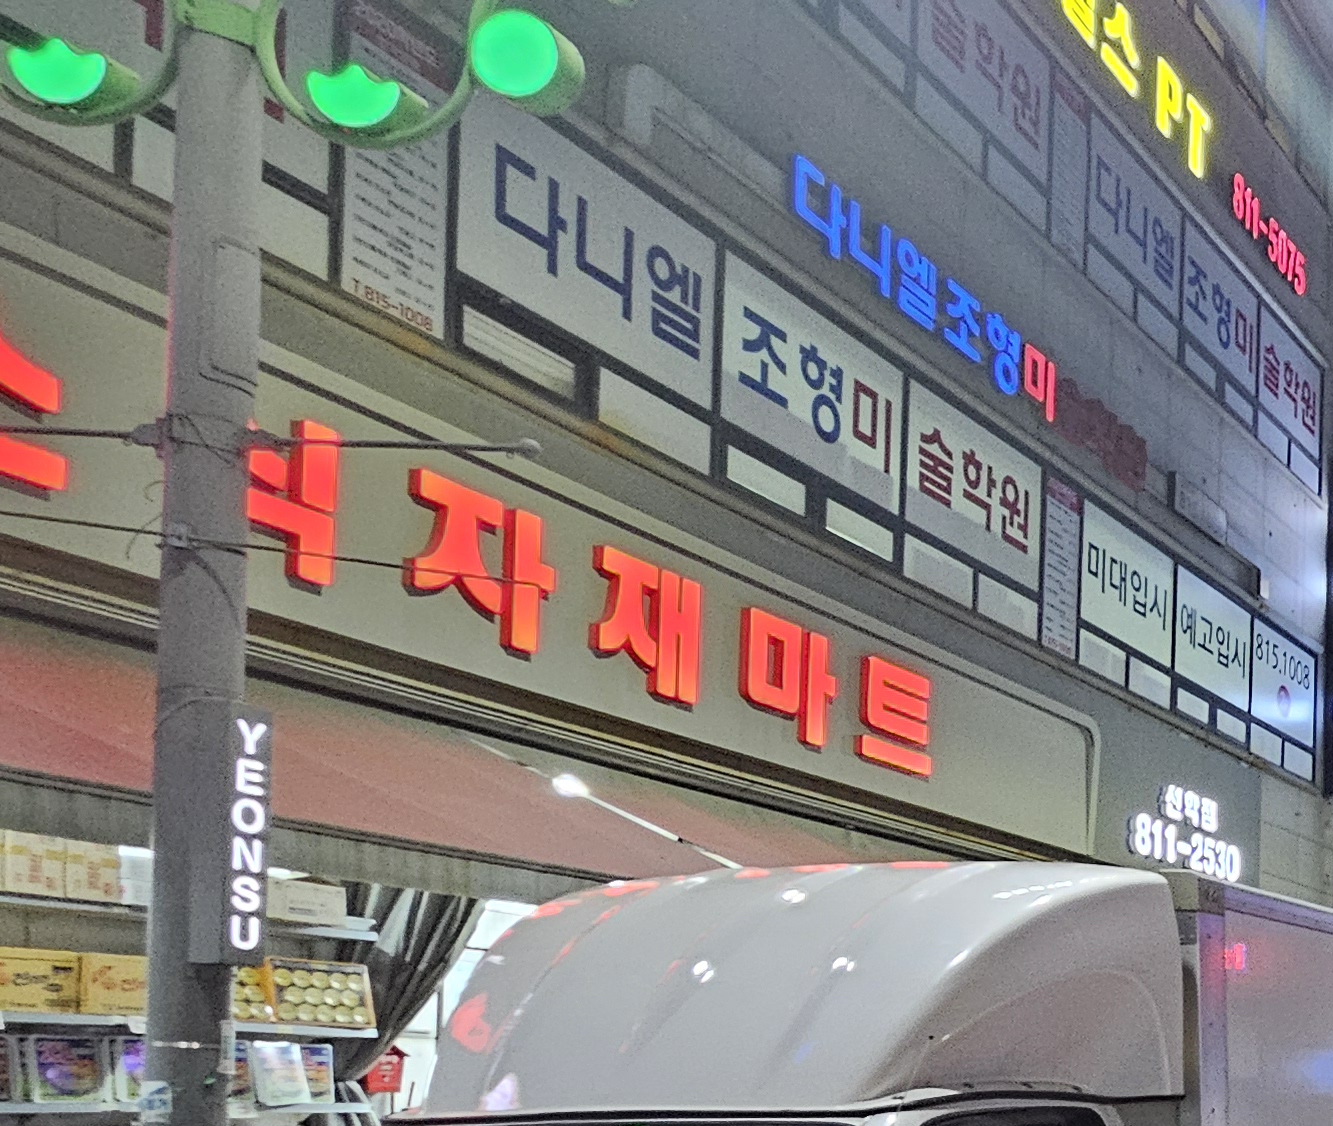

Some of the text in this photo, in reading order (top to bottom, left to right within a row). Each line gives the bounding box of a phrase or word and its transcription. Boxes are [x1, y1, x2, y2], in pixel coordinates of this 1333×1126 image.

[1156, 55, 1212, 179] PT
[1095, 153, 1317, 437] 다니엘 조형미 술학원
[1232, 172, 1307, 296] 811-5075
[495, 142, 702, 362] 다니엘
[738, 306, 893, 477] 조형미
[918, 425, 1030, 557] 술학원
[1087, 543, 1169, 634] 미대입시
[1180, 602, 1248, 681] 예고입시
[1254, 633, 1312, 695] 815.1008
[228, 717, 269, 952] YEONSU
[1134, 812, 1241, 883] 811-2530
